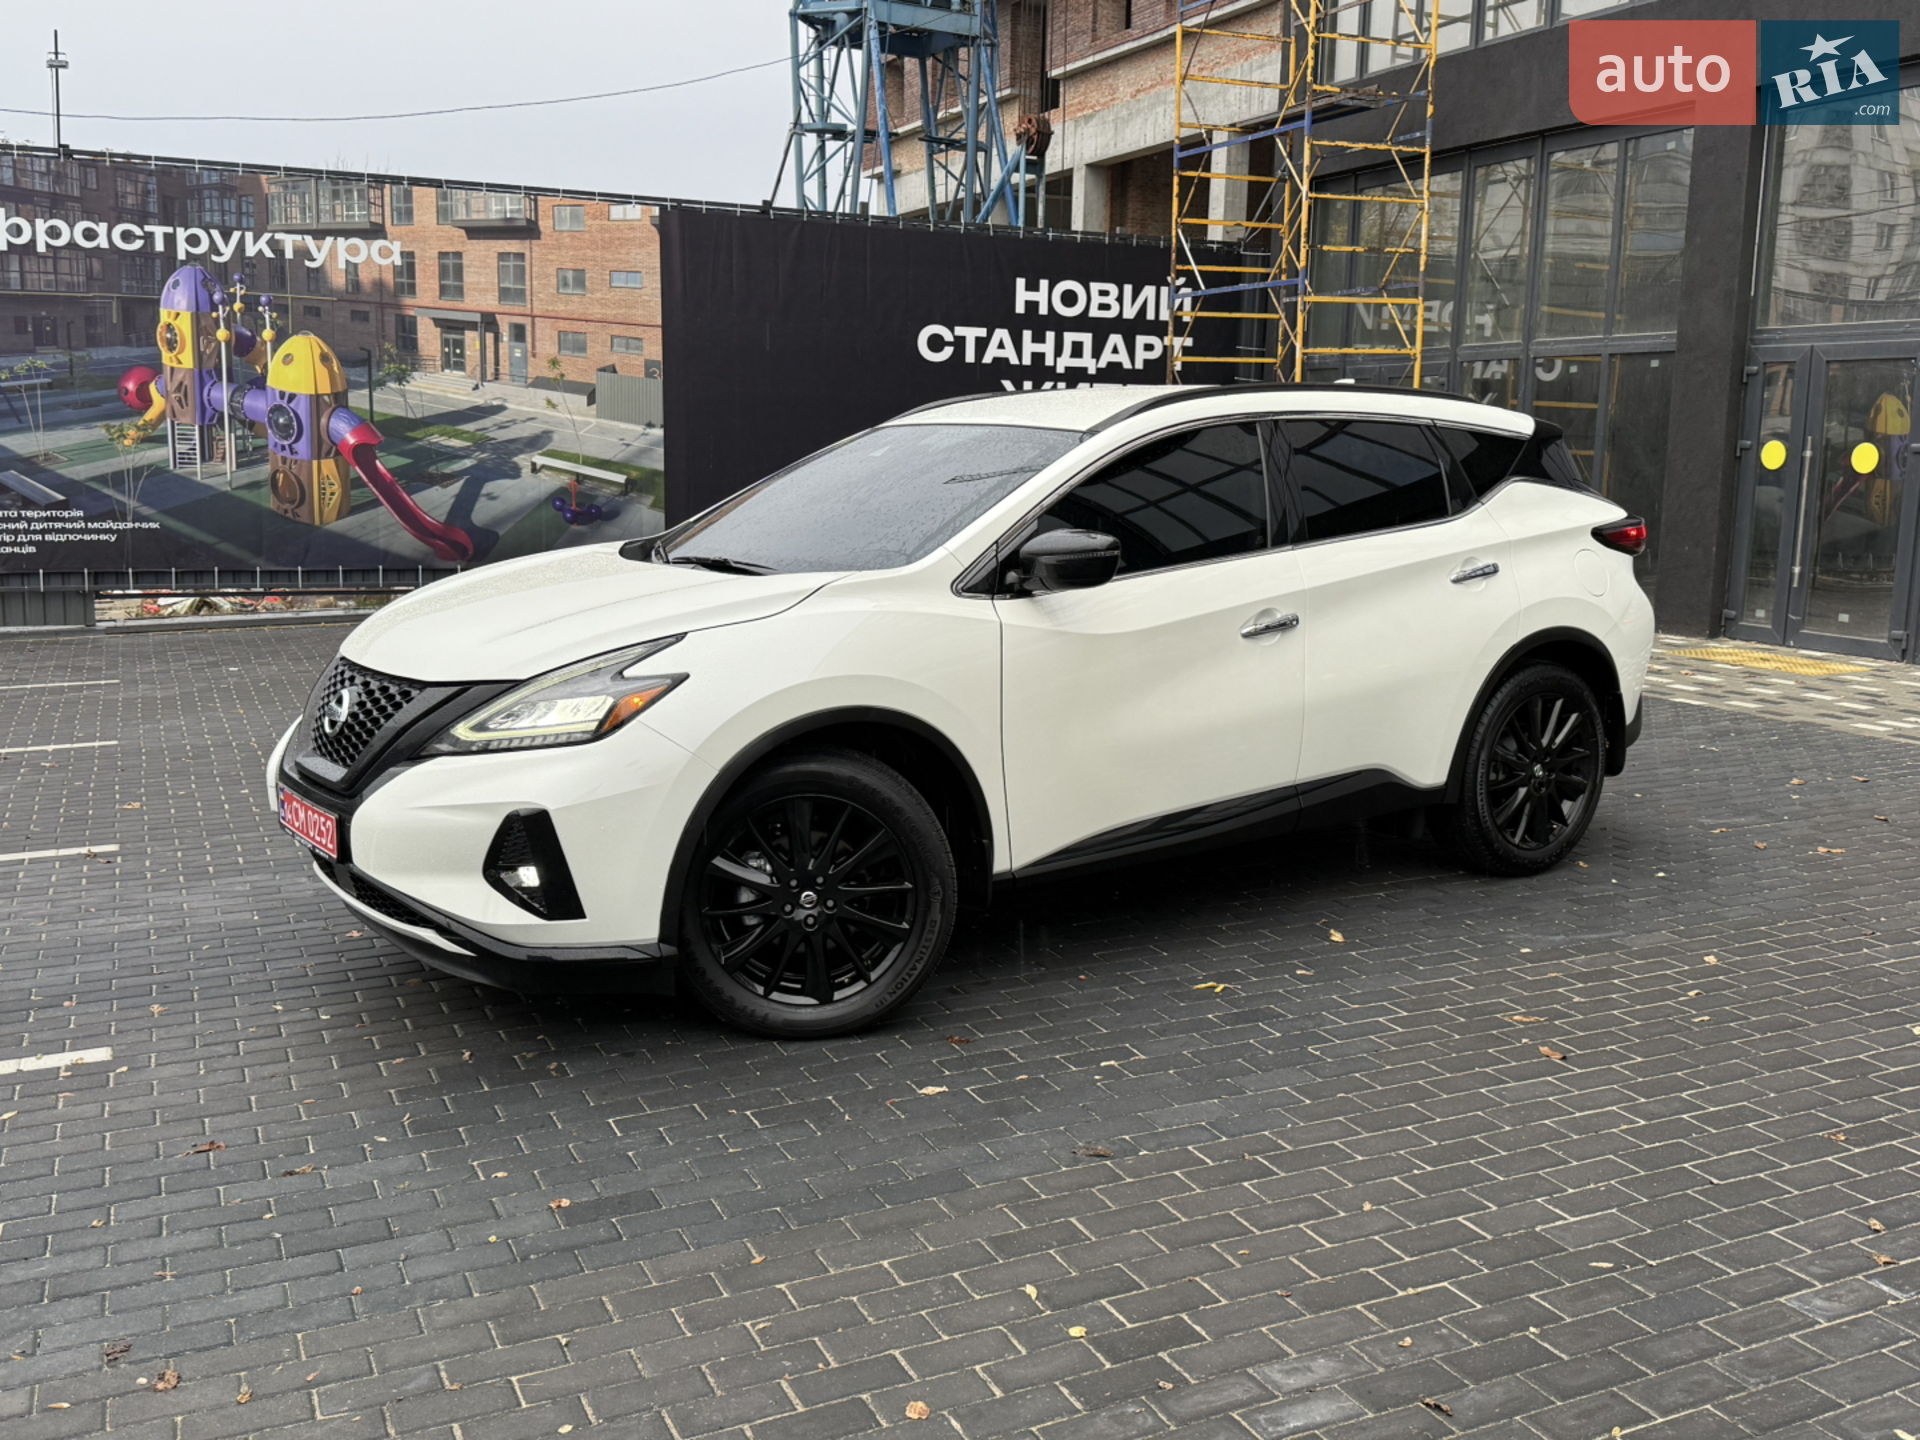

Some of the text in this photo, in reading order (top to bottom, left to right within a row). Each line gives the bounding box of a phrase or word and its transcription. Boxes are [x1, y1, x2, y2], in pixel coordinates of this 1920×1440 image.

[917, 323, 1193, 375] СТАНДАРТ
[19, 508, 84, 519] територія
[30, 520, 86, 531] дитячий
[87, 520, 160, 530] майданчик
[17, 534, 42, 543] для
[45, 532, 117, 542] відпочинку
